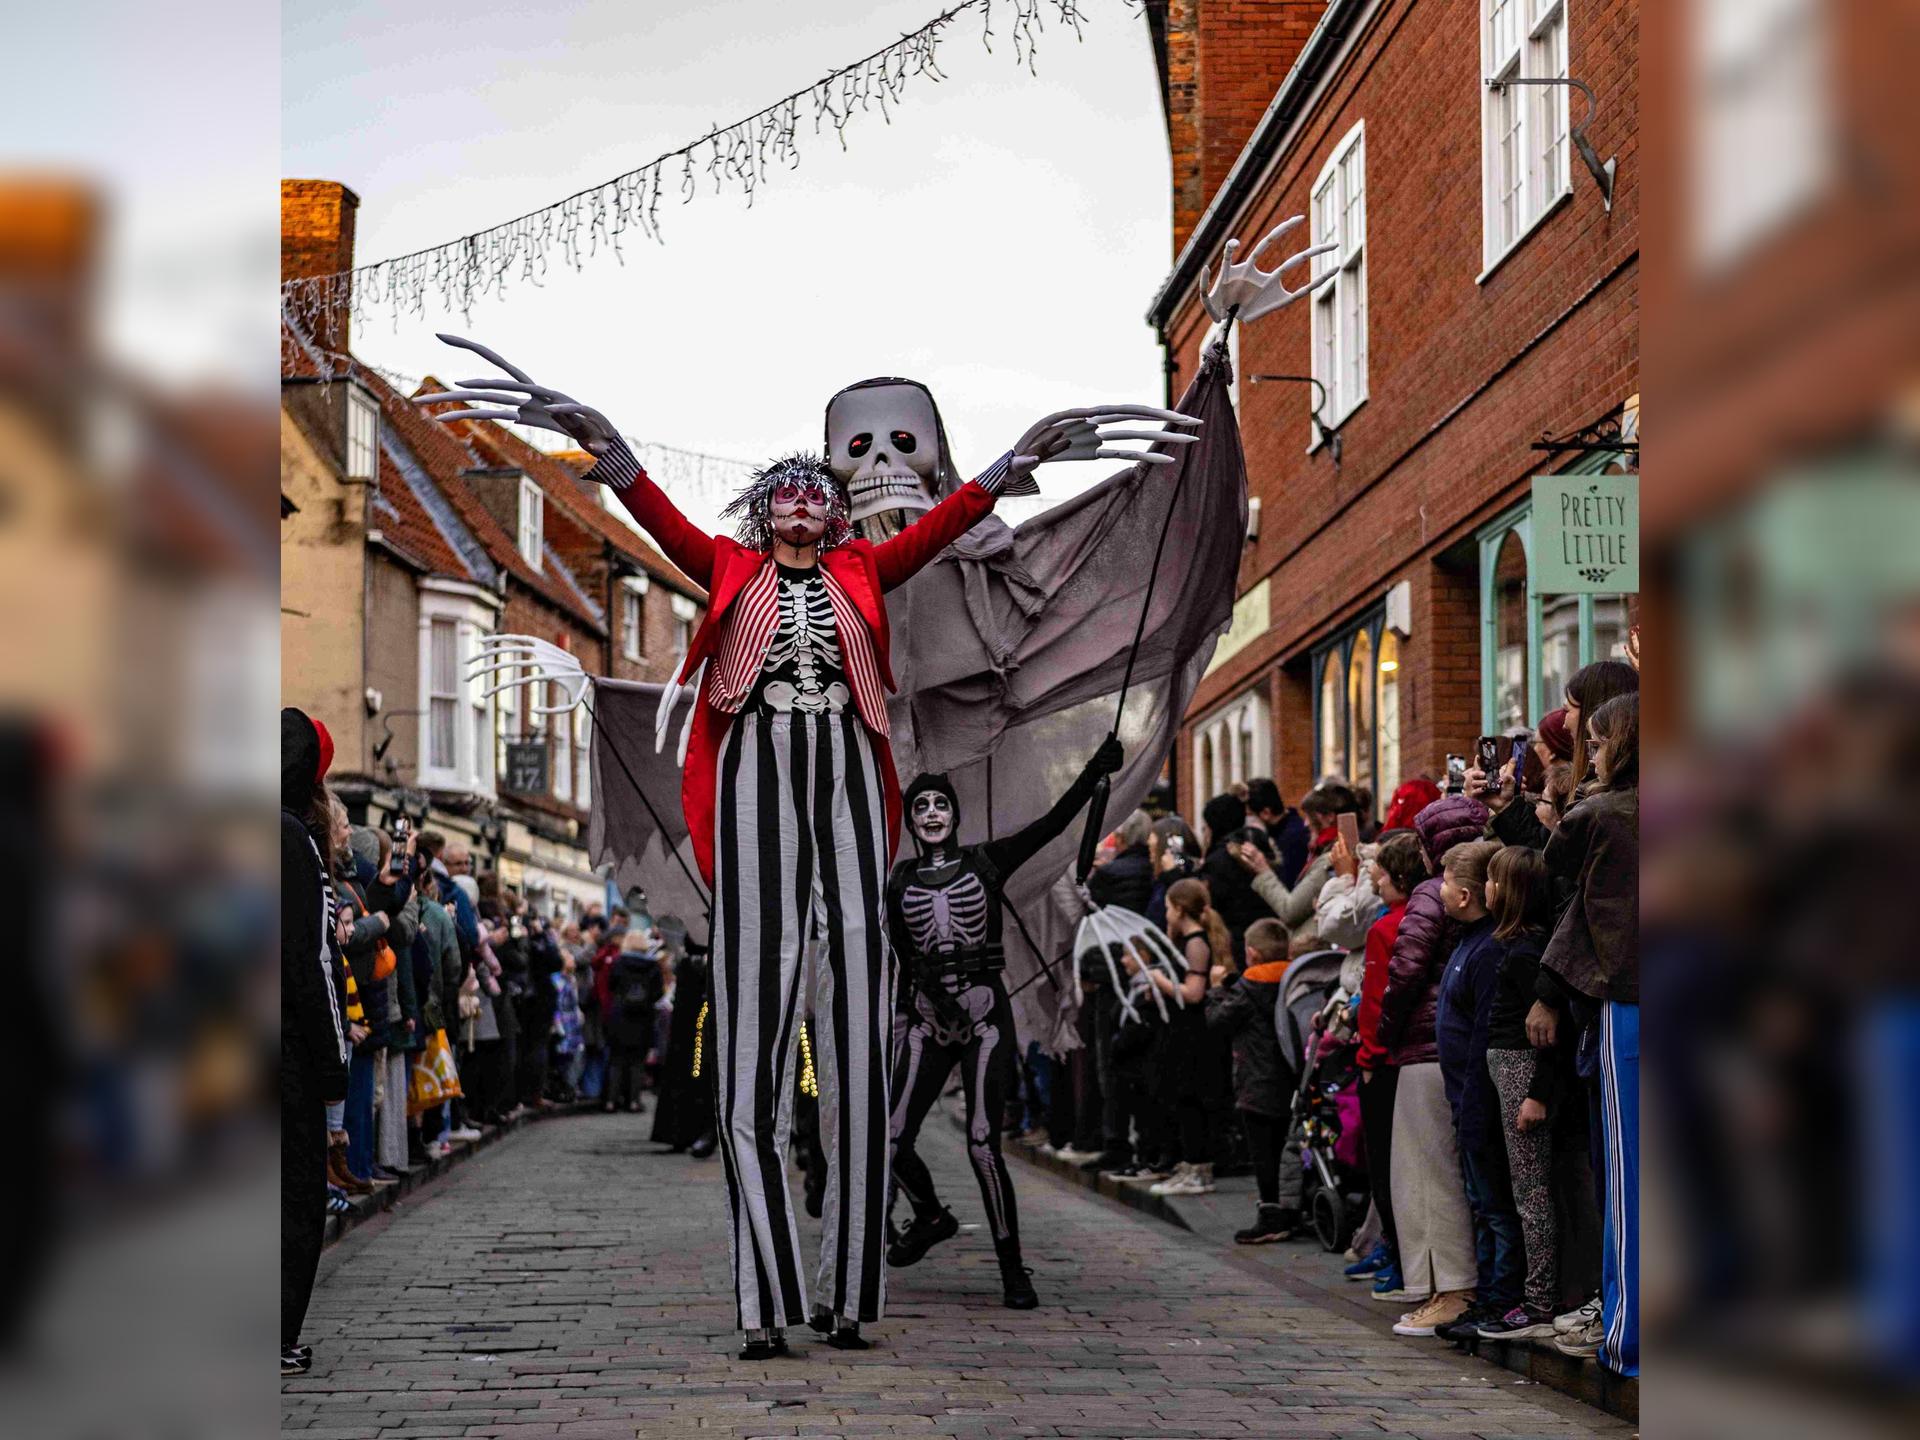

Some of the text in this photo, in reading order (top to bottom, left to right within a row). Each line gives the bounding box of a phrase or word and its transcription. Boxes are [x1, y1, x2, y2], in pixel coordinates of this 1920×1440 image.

[1561, 493, 1625, 527] PRETTY
[1562, 530, 1627, 565] LITTLE
[513, 767, 540, 791] 17
